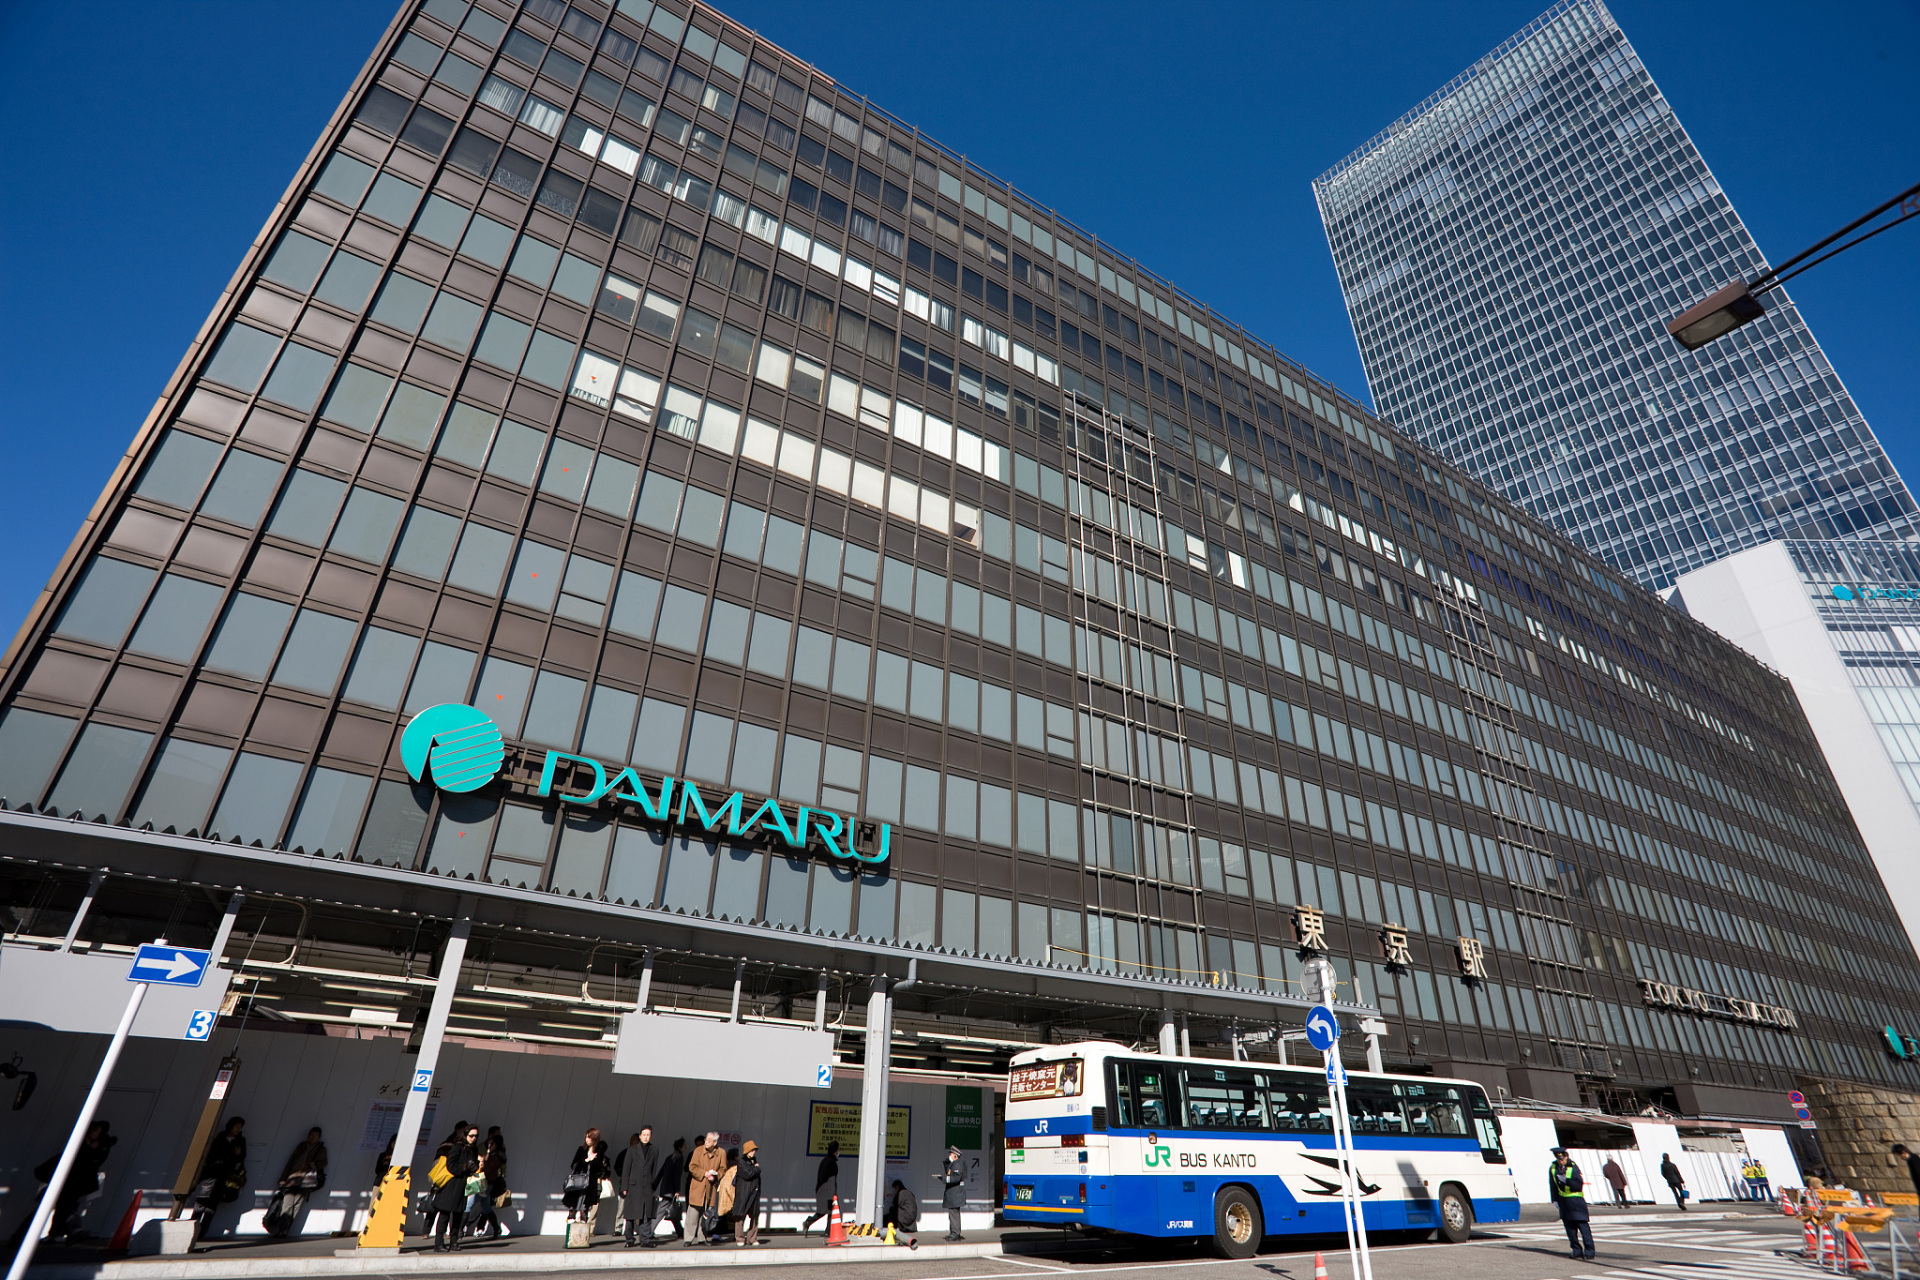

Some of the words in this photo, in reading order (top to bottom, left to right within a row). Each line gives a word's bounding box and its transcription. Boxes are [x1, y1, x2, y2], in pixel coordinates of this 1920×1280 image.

[537, 749, 891, 864] DAIMARU
[1294, 904, 1488, 979] 東京駅
[1638, 978, 1709, 1013] TOKYO
[1727, 996, 1799, 1029] STATION
[189, 1011, 213, 1038] 3
[417, 1075, 428, 1086] 2
[818, 1065, 830, 1086] 2
[1011, 1081, 1055, 1093] 共販センター
[1034, 1120, 1048, 1134] JR
[1145, 1146, 1171, 1167] JR
[1180, 1153, 1207, 1168] BUS
[1213, 1153, 1256, 1168] KANTO
